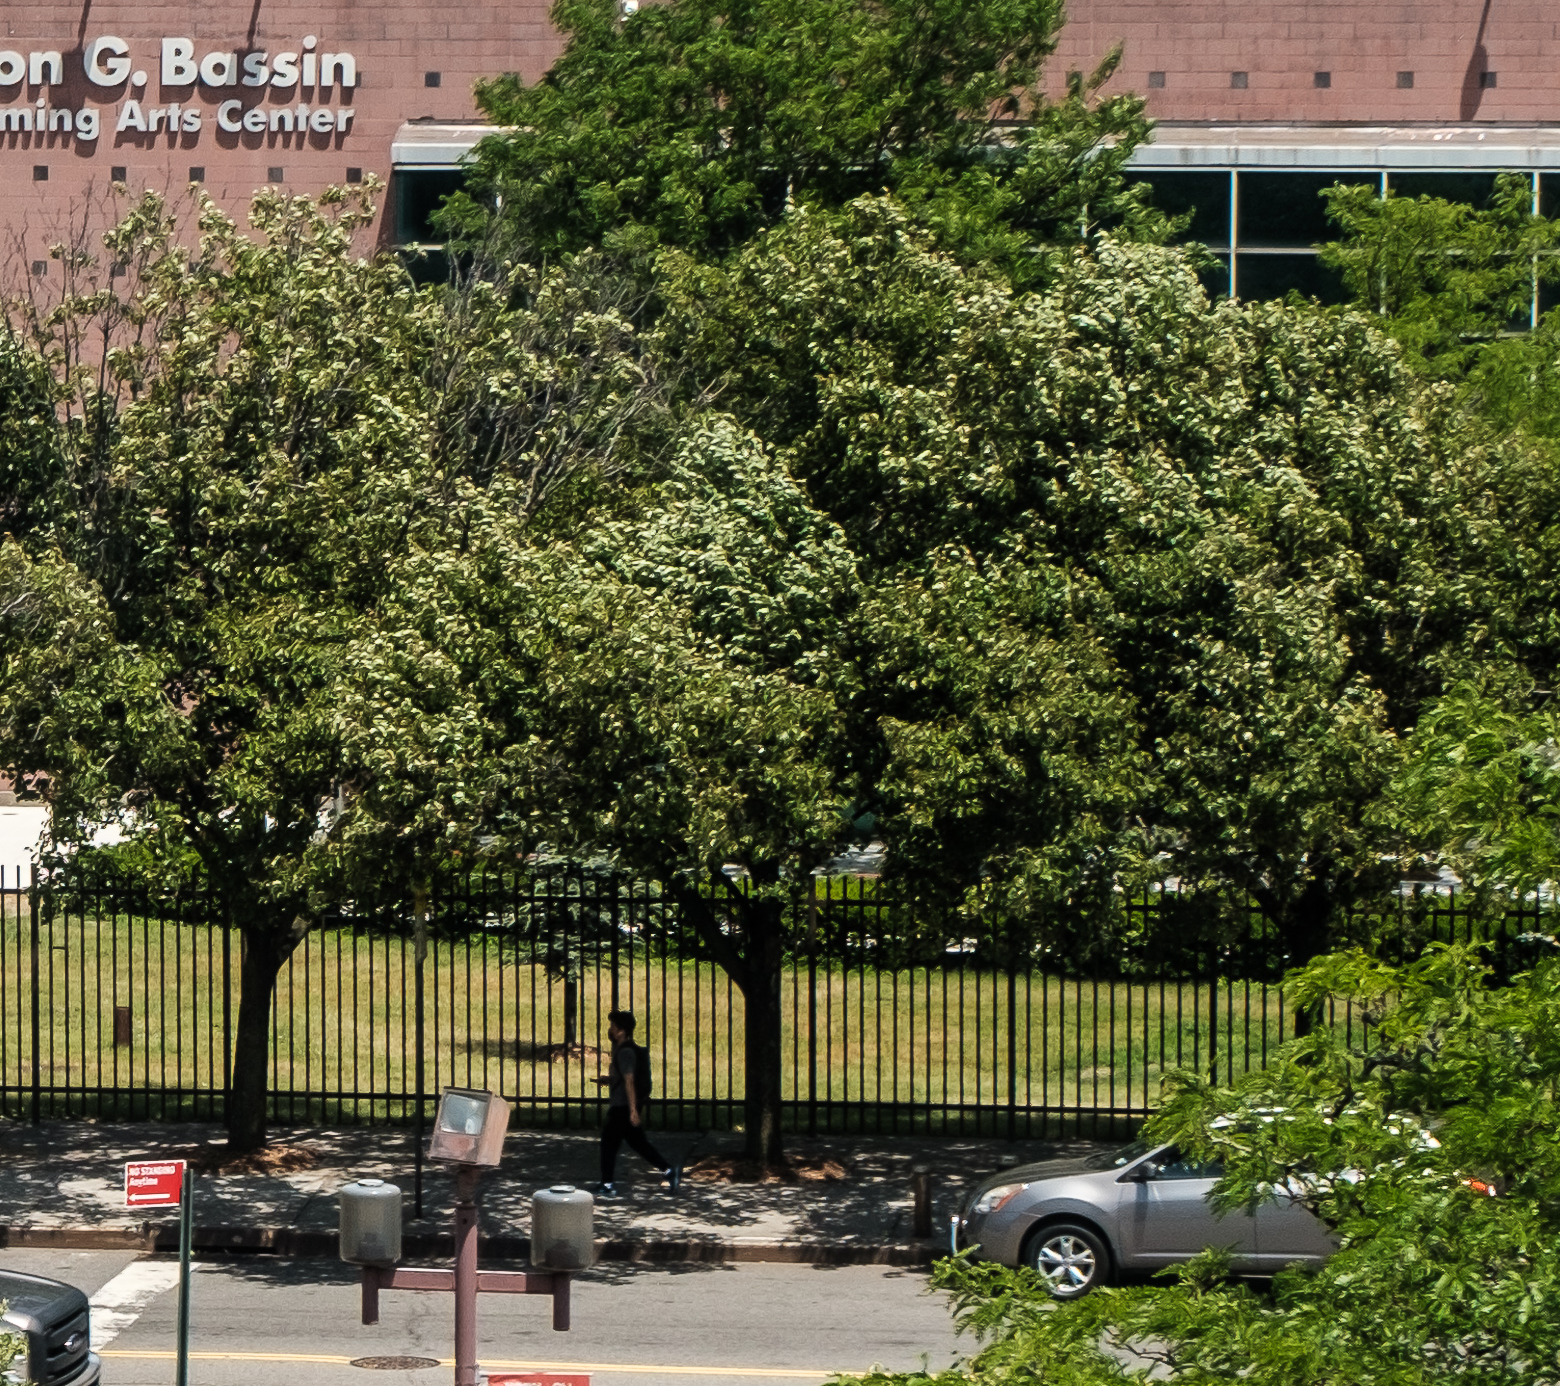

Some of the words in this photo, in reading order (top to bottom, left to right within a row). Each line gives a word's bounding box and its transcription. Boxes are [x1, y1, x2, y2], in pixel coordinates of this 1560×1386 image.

[83, 35, 148, 88] G.
[162, 35, 357, 88] Bassin
[116, 99, 201, 133] Arts
[216, 100, 355, 133] Center
